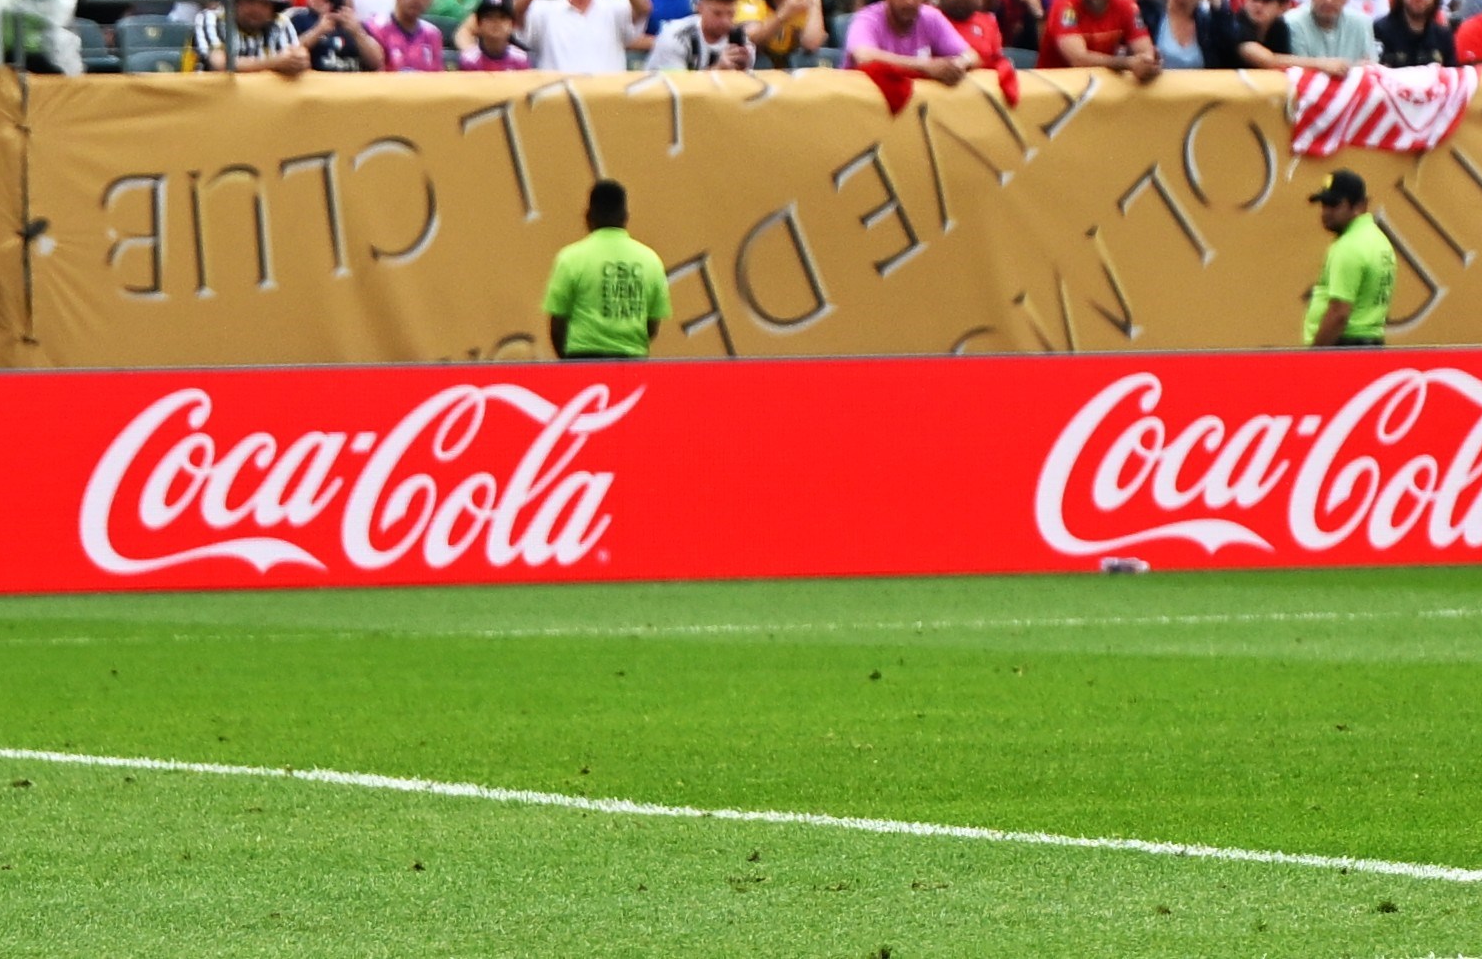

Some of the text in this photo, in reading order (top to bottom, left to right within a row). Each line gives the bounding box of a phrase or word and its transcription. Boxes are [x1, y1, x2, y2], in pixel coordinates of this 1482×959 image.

[100, 135, 440, 301] CLUB
[603, 261, 643, 279] CSC
[602, 279, 644, 300] EVENT
[602, 300, 644, 319] STAFF
[78, 384, 646, 575] Coca-Cola
